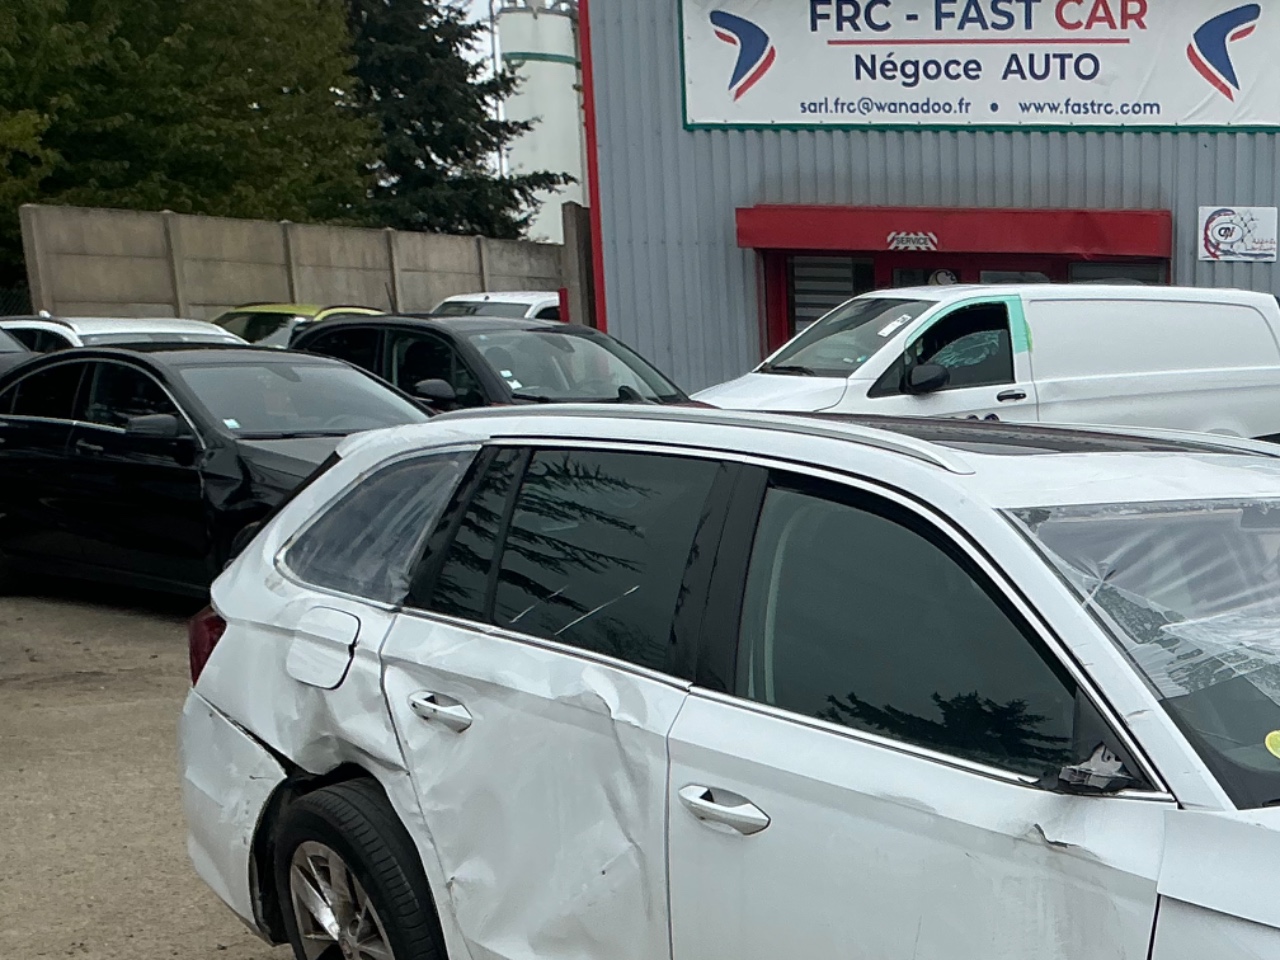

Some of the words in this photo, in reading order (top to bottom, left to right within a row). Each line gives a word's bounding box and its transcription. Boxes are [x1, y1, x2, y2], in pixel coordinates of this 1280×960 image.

[810, 0, 891, 32] FRC
[935, 0, 1042, 31] FAST
[1055, 0, 1149, 30] CAR
[855, 51, 982, 88] Négoce
[1002, 53, 1100, 80] AUTO
[800, 97, 971, 115] sarl.frc@wanadoo.fr
[1018, 98, 1161, 115] www.fastrc.com
[895, 236, 930, 246] SERVICE
